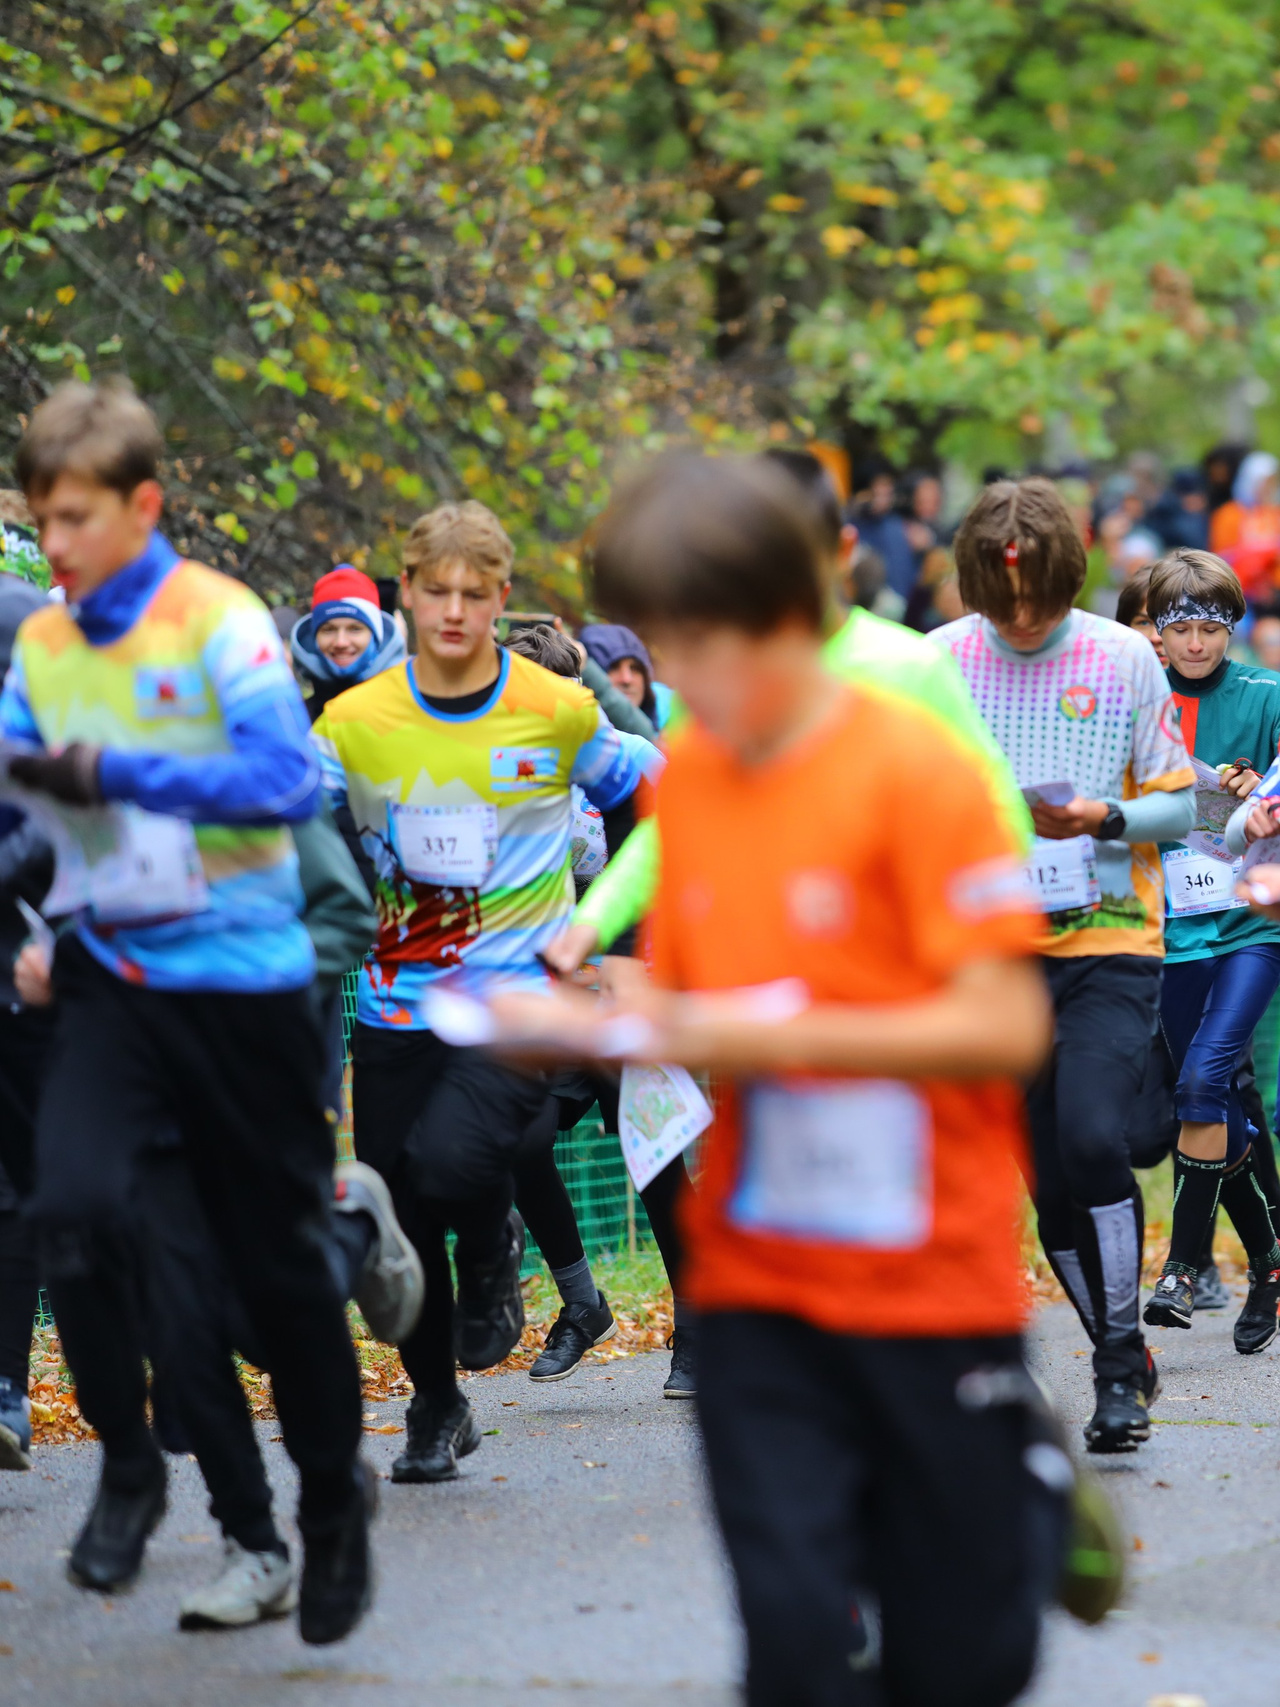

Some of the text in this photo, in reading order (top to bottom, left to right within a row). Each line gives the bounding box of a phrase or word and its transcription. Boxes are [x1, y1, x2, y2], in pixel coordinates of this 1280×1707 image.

[422, 836, 458, 856] 337
[1023, 866, 1059, 886] 312
[1184, 871, 1214, 891] 346
